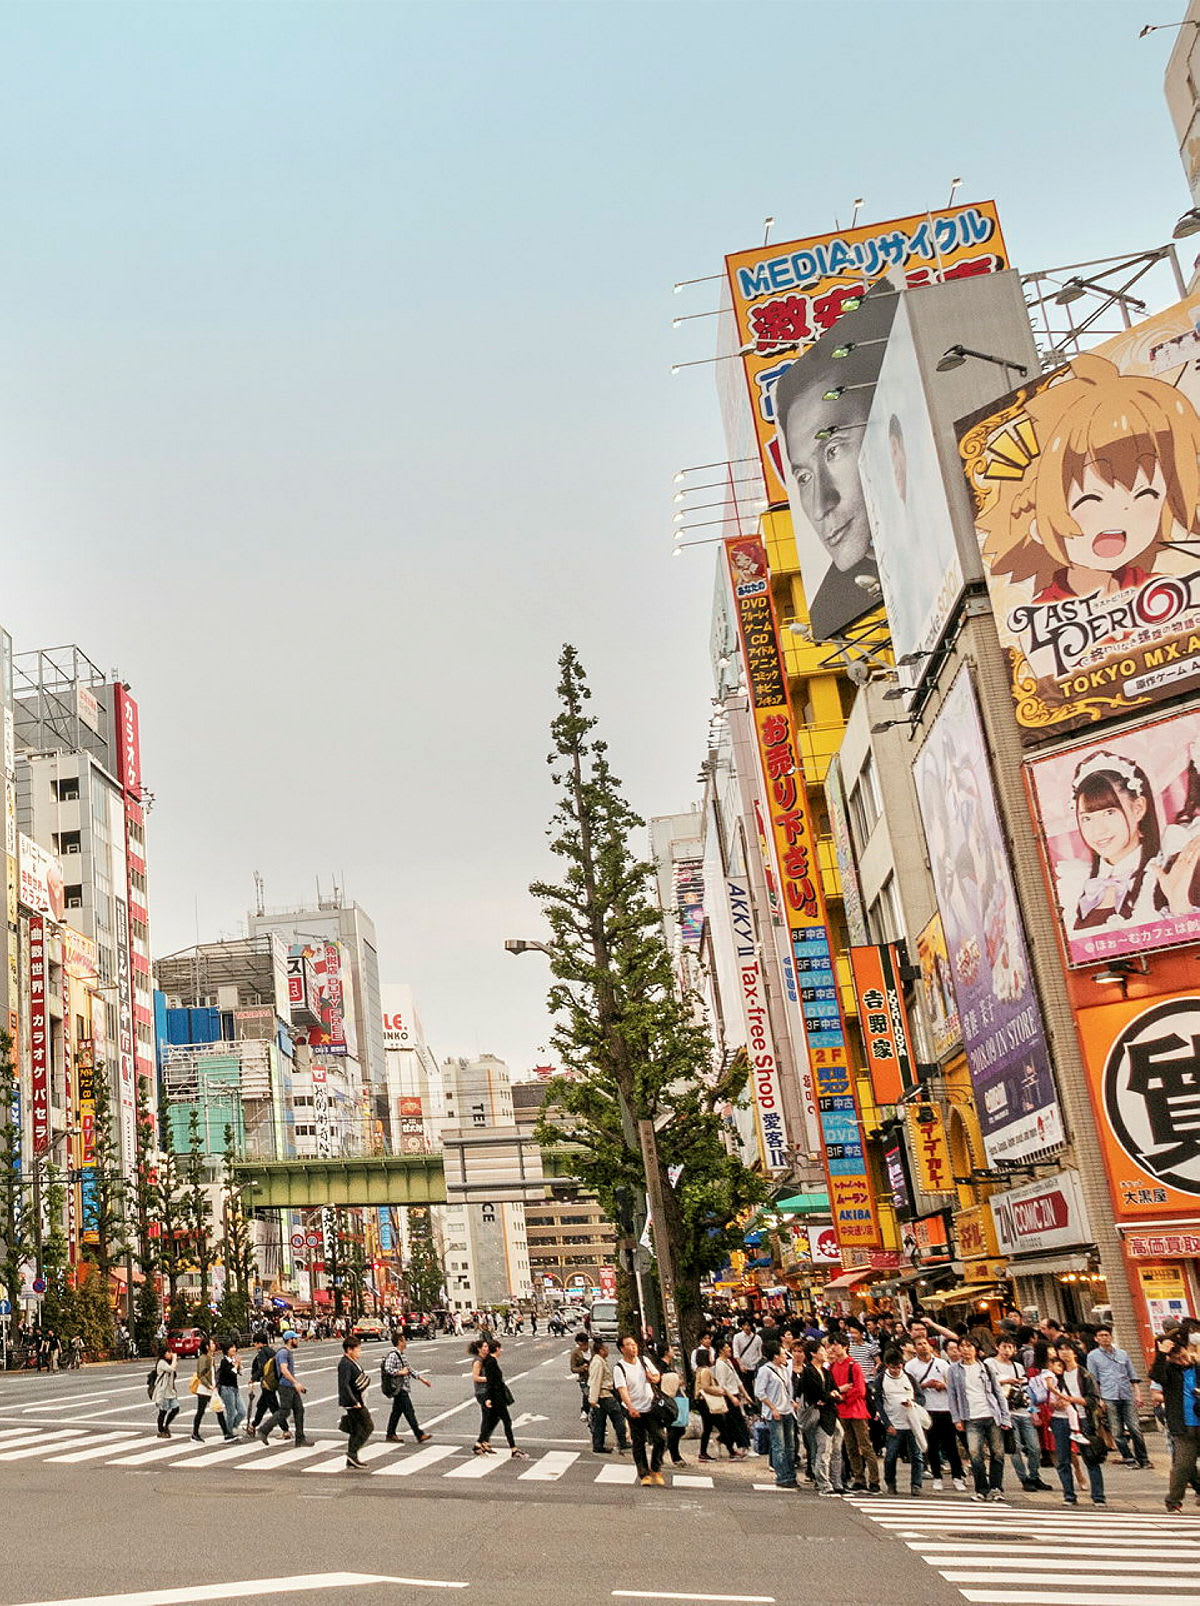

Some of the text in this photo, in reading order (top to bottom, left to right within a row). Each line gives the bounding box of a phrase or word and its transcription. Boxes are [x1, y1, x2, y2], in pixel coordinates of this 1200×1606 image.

[741, 597, 767, 610] DVD
[744, 621, 772, 634] ゲーム
[1007, 589, 1102, 655] LAST
[750, 633, 769, 645] CD
[749, 657, 778, 670] アニメ
[1059, 660, 1137, 698] TOKYO
[125, 700, 137, 786] カラオケ
[727, 882, 753, 944] AKKY
[796, 958, 831, 970] 5F 中古
[801, 988, 836, 1000] 4F 中古
[740, 960, 768, 1052] Tax-free
[806, 1006, 837, 1017] DVD
[806, 1018, 841, 1030] 3F 中古
[862, 989, 894, 1060] 吉野家
[1007, 1006, 1037, 1050] STORE
[753, 1053, 775, 1110] Shop
[819, 1097, 854, 1110] 1F 中古
[825, 1129, 858, 1142] DVD
[1123, 1188, 1168, 1204] 大黒屋
[839, 1209, 871, 1220] AKIBA
[1130, 1236, 1200, 1255] 高価買取
